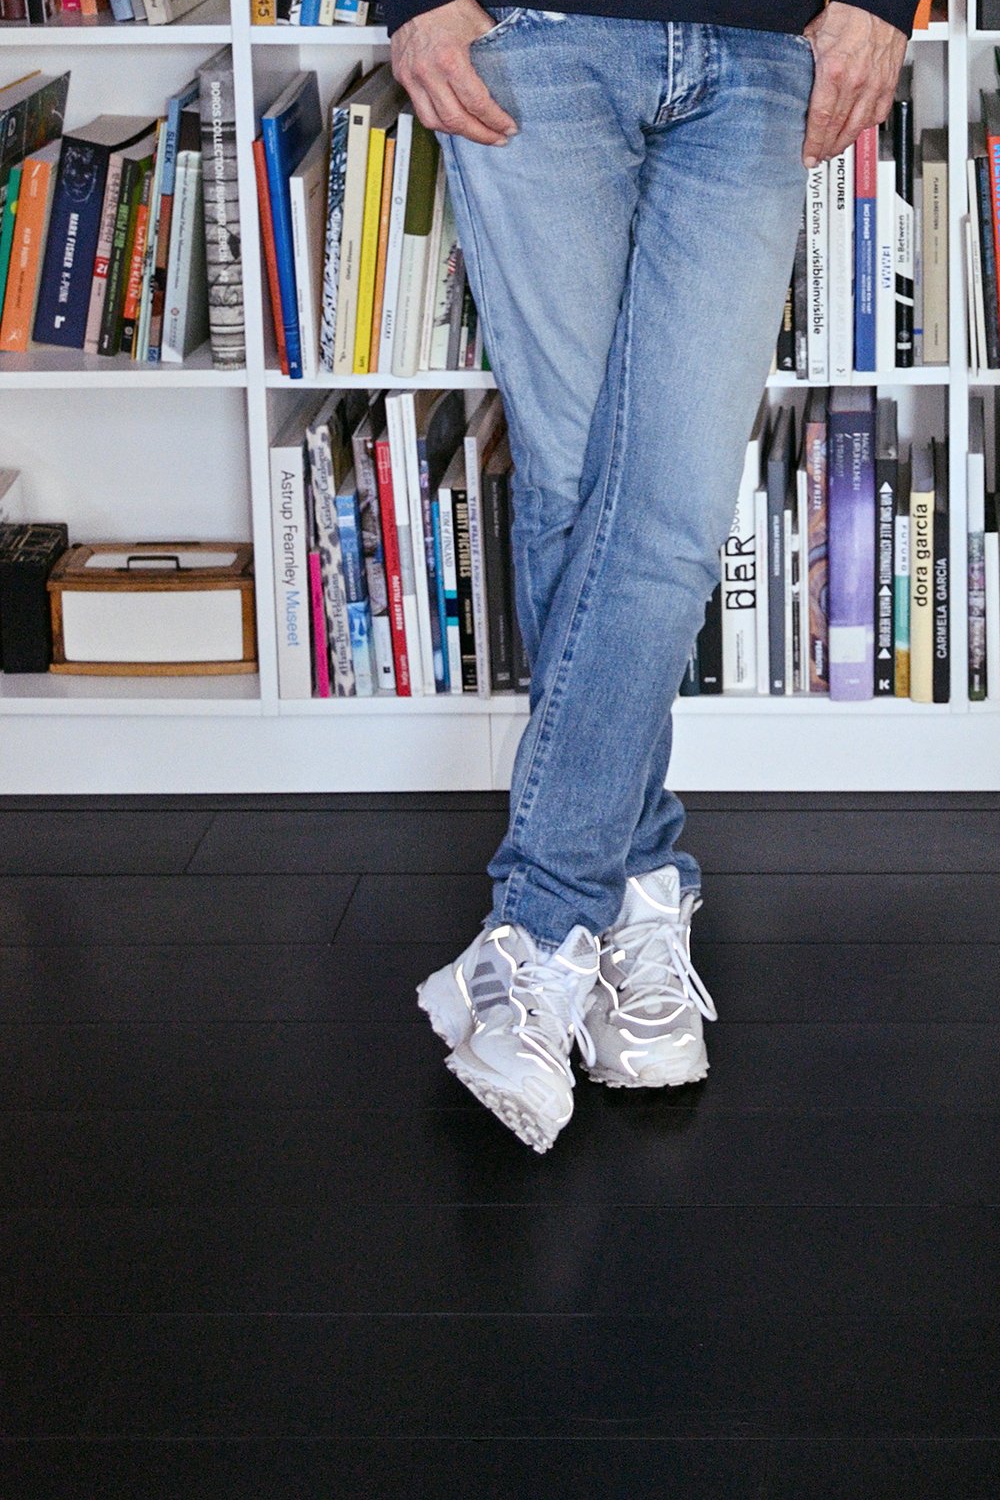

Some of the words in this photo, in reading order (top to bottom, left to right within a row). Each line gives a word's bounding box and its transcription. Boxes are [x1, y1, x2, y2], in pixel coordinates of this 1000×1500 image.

[210, 81, 222, 117] BOROS
[164, 131, 175, 164] SLEEK
[212, 119, 225, 180] COLLECTION
[811, 172, 822, 199] Wyn
[836, 158, 845, 211] PICTURES
[67, 213, 79, 237] MARK
[812, 202, 822, 235] Evans
[63, 238, 77, 268] FISHER
[280, 470, 299, 520] Astrup
[458, 503, 469, 529] DIRTY
[913, 504, 930, 560] garcía
[281, 525, 299, 586] Fearnley
[459, 531, 471, 578] PICTURES
[914, 567, 928, 607] dora
[935, 558, 947, 601] GARCÍA
[285, 590, 300, 646] Museet
[936, 605, 947, 659] CARMELA
